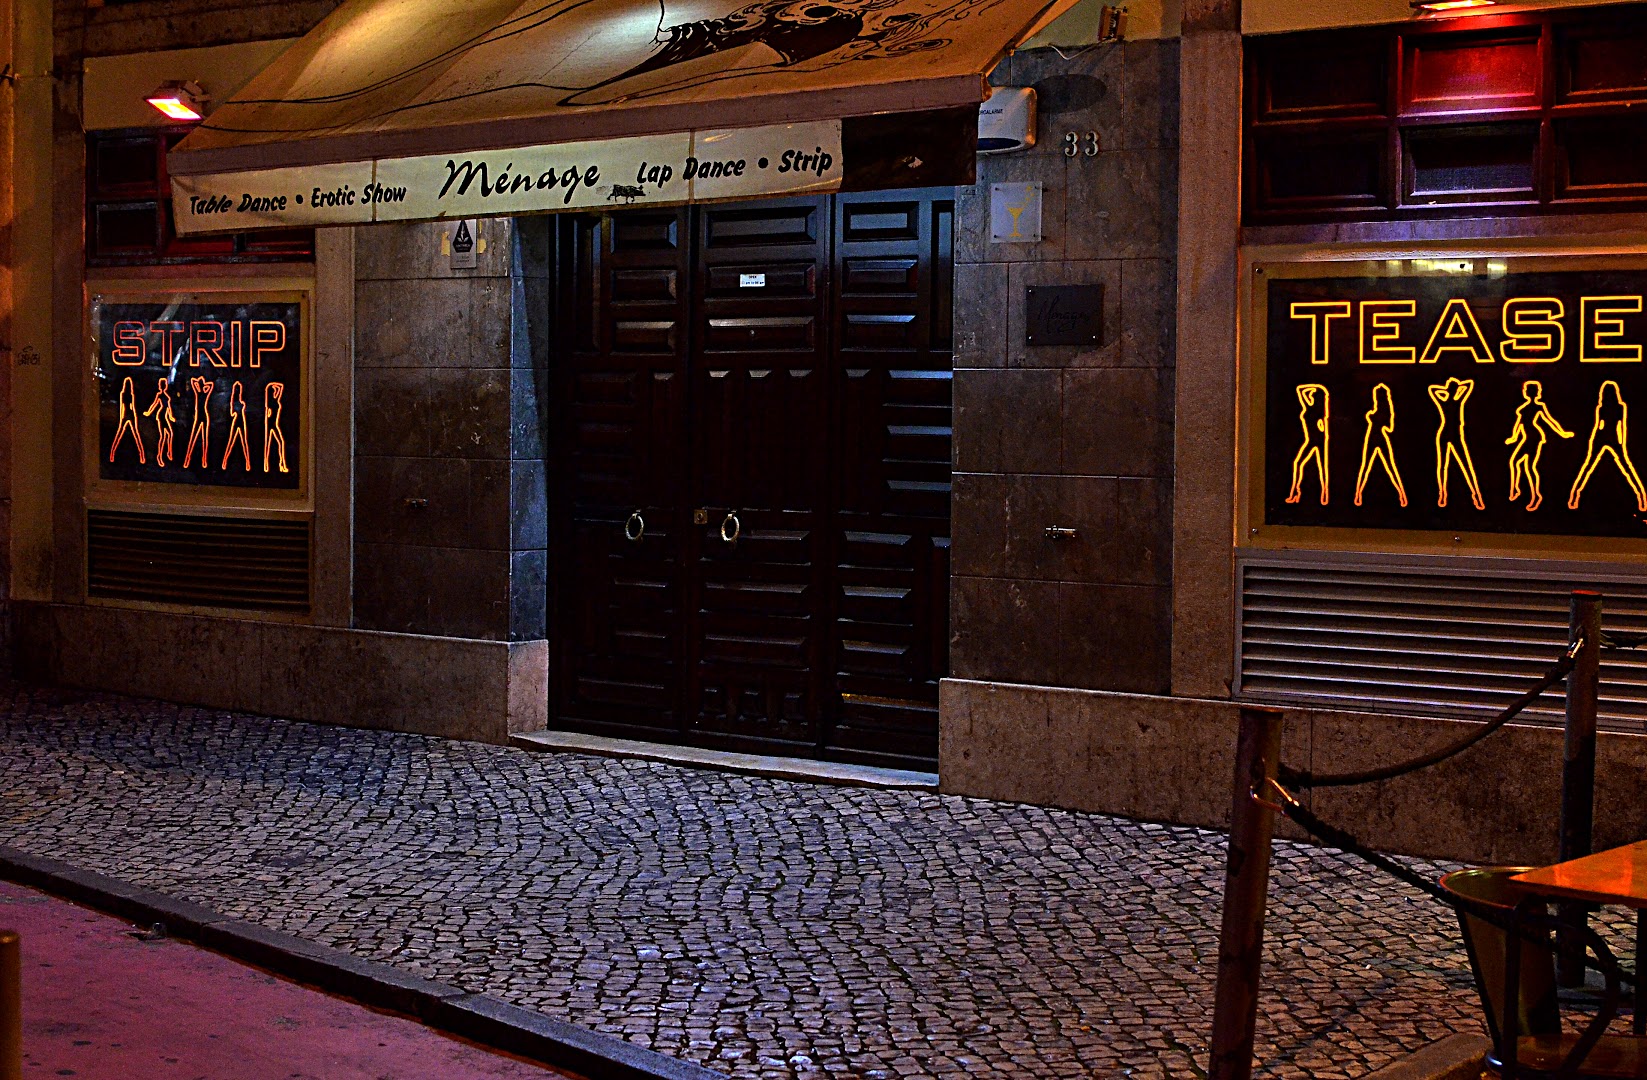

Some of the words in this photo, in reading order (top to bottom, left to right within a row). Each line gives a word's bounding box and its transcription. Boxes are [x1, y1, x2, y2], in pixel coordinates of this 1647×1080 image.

[1064, 131, 1099, 157] 33
[190, 194, 233, 215] Table
[236, 193, 288, 213] Dance
[311, 185, 356, 208] Erotic
[361, 182, 407, 204] Show
[438, 159, 601, 205] Ménage
[636, 161, 673, 188] Lap
[682, 157, 746, 180] Dance
[778, 146, 833, 177] Strip
[112, 321, 286, 368] STRIP
[1290, 296, 1642, 364] TEASE
